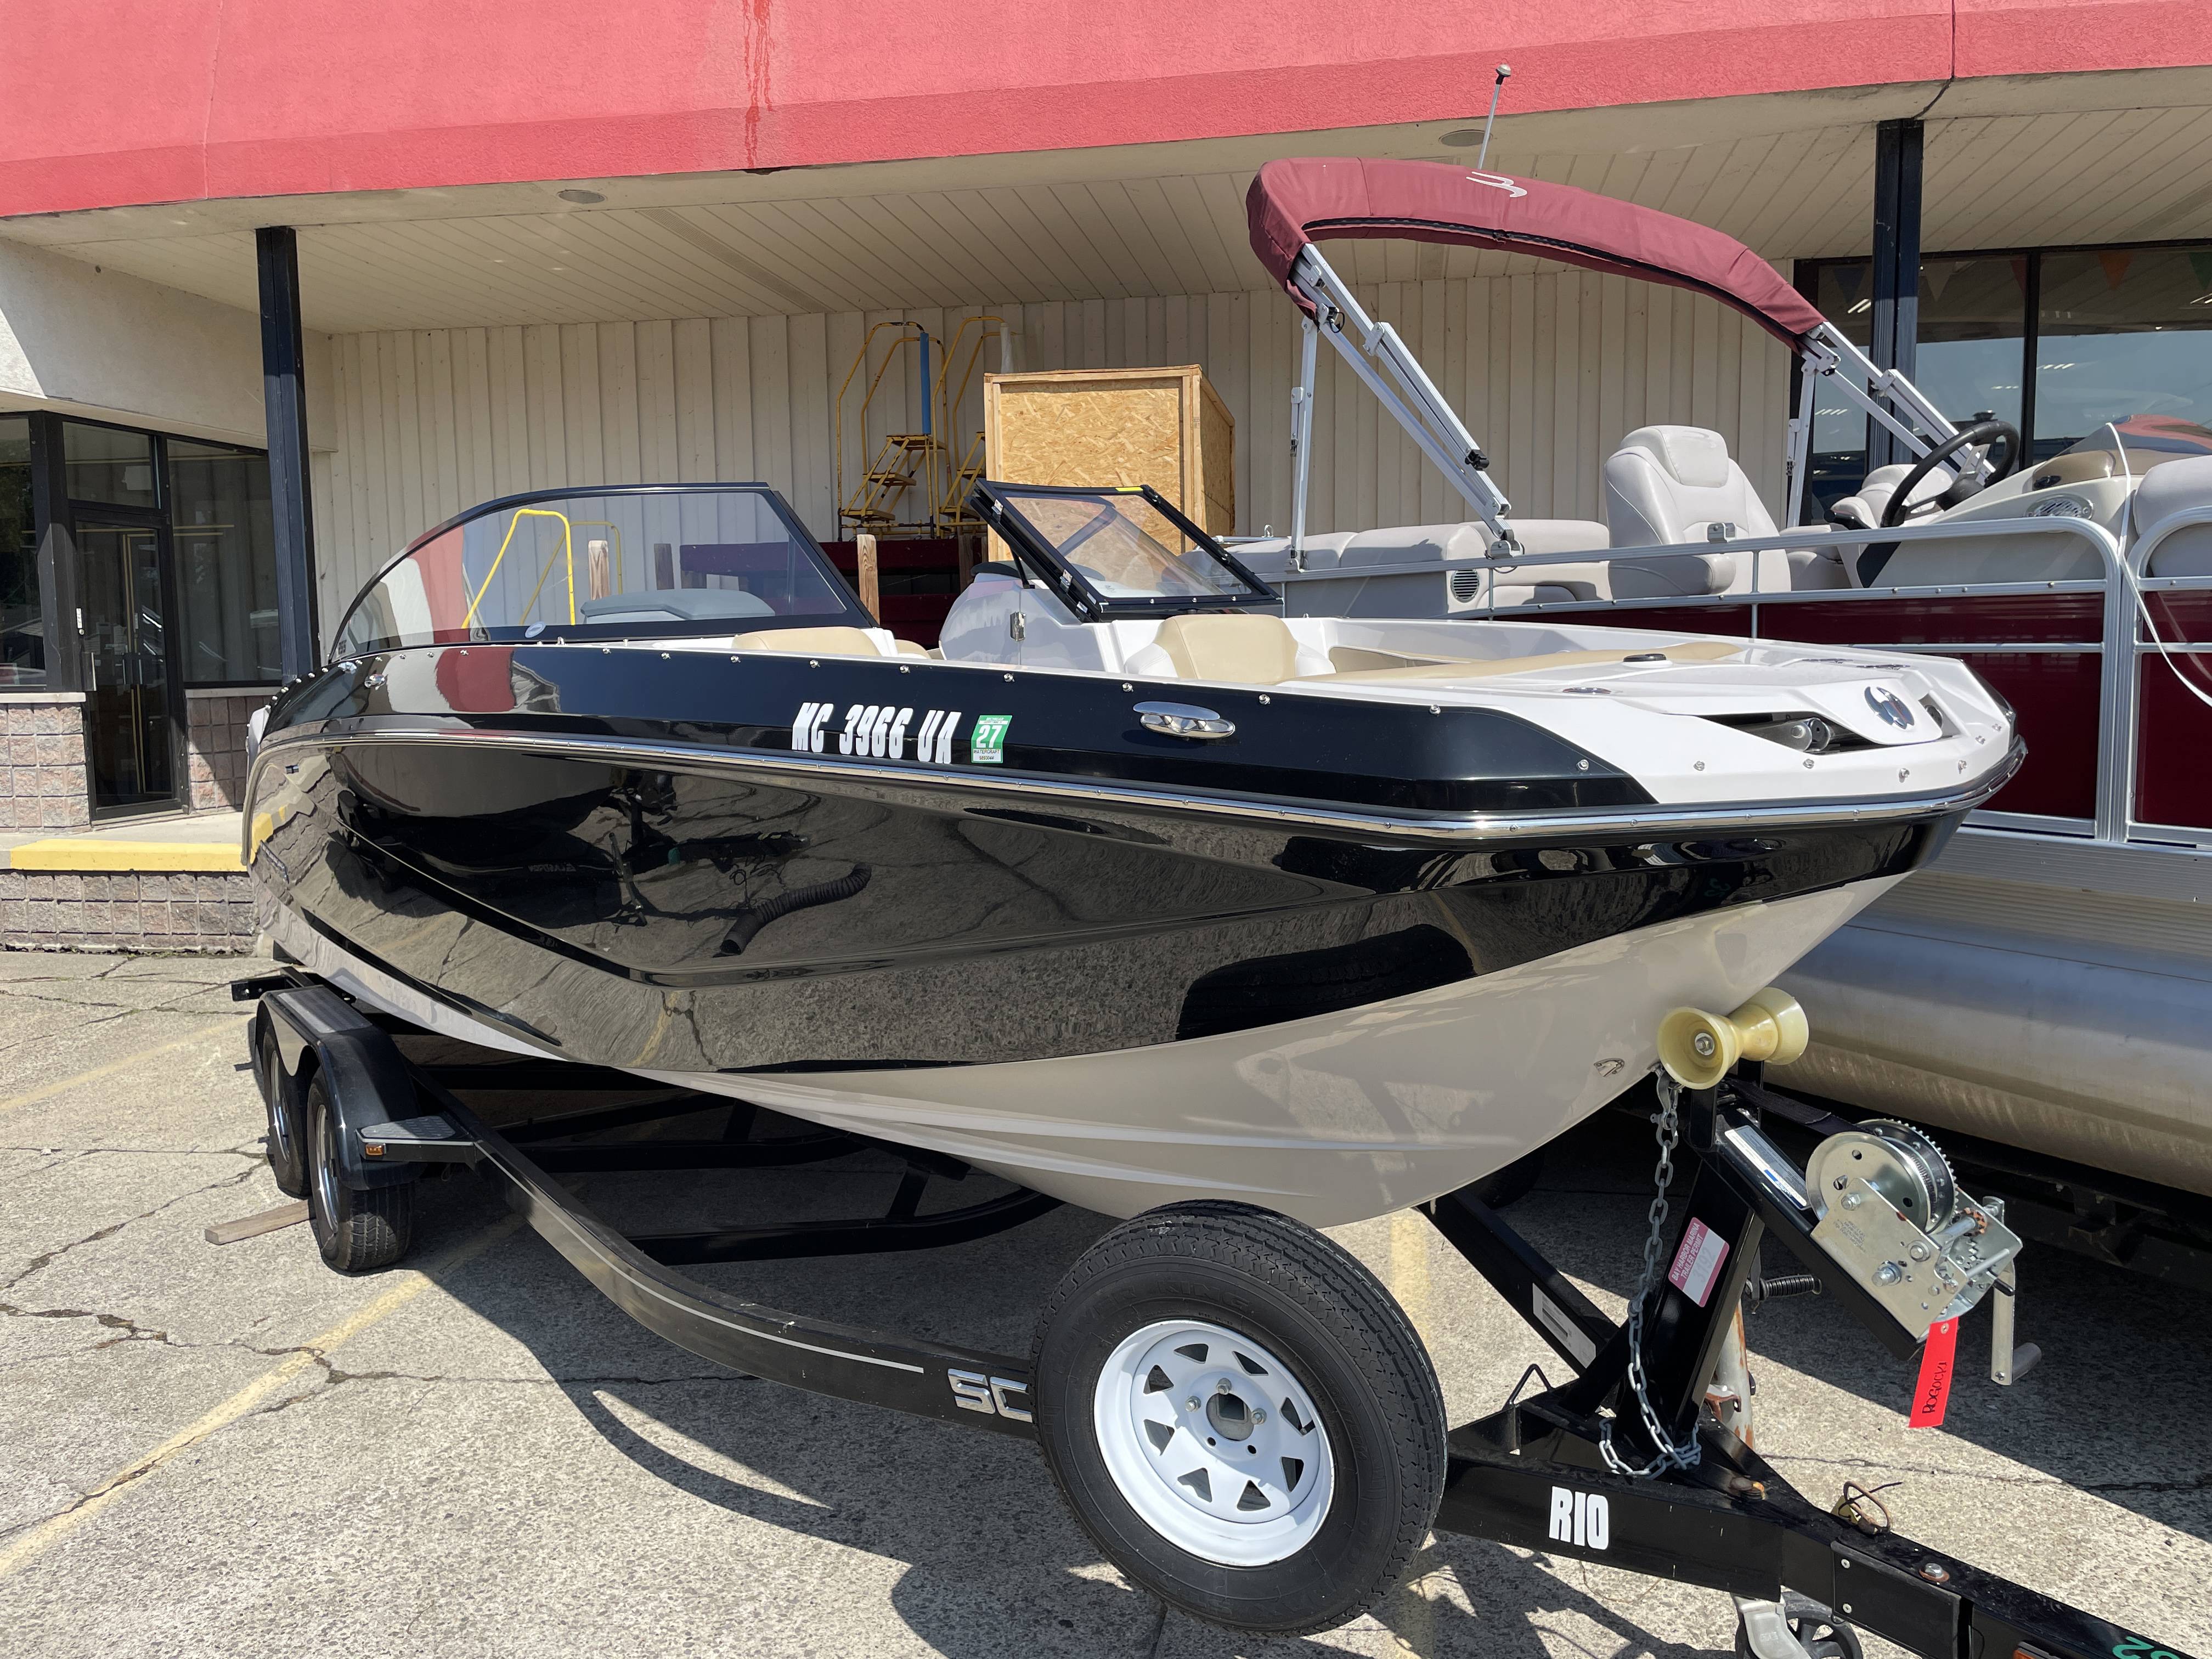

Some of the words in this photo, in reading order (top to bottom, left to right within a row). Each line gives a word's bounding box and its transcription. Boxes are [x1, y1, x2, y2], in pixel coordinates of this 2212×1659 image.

[792, 702, 834, 753] MC
[839, 704, 913, 759] 3966
[917, 710, 962, 764] UA
[976, 725, 1003, 748] 27
[1677, 1242, 1691, 1271] HARBOR
[1686, 1222, 1700, 1245] MARINA
[1680, 1250, 1695, 1279] TRAILER
[1690, 1233, 1703, 1256] PERMIT
[947, 1368, 1032, 1423] SC
[1548, 1486, 1609, 1550] RIO
